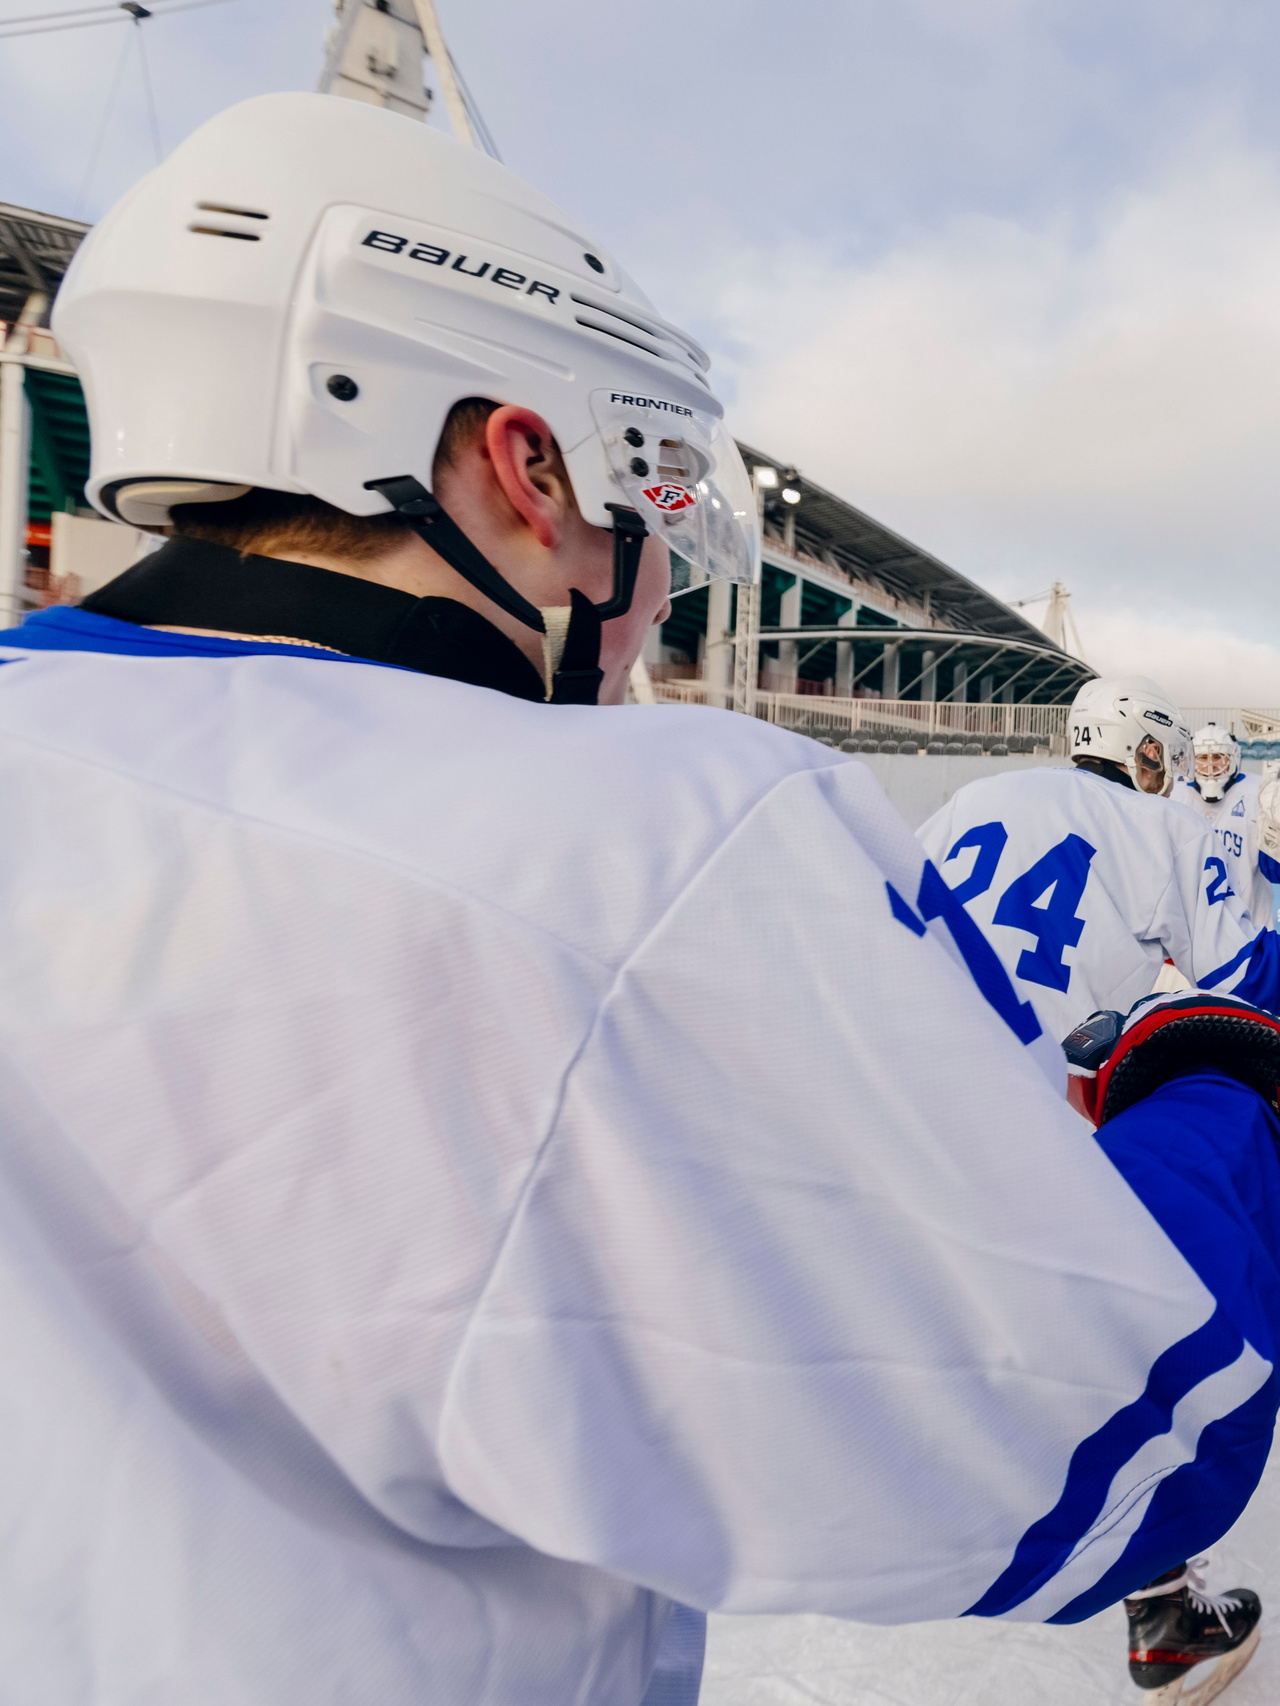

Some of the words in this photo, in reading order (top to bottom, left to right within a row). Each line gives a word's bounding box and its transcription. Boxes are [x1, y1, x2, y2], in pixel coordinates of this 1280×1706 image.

[361, 228, 561, 306] BAUER
[610, 393, 693, 418] FRONTIER
[660, 490, 680, 503] F
[1074, 725, 1092, 747] 24
[1203, 856, 1235, 906] 2
[942, 821, 1097, 994] 24
